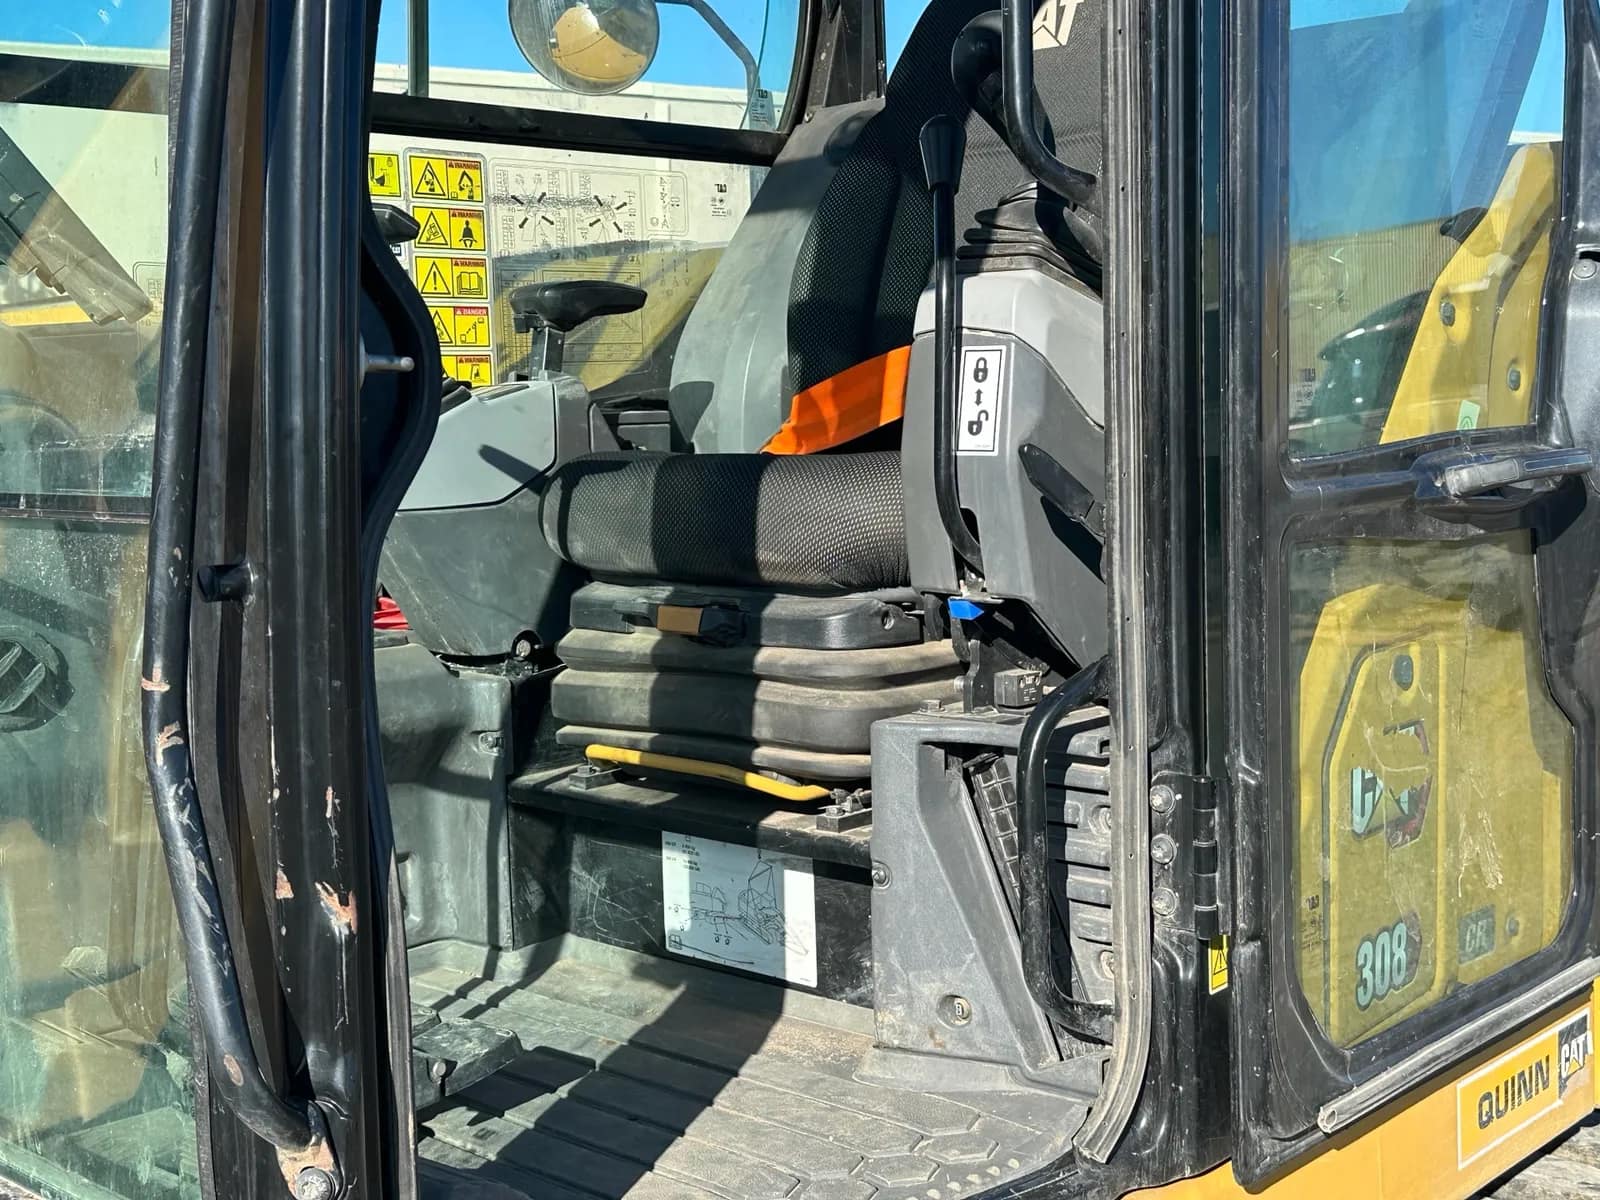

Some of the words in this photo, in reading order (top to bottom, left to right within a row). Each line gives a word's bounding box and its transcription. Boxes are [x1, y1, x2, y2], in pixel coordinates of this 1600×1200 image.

[1032, 0, 1085, 50] AT
[454, 162, 480, 170] WARNING
[1355, 920, 1409, 1009] 308
[1477, 1053, 1551, 1130] QUINN
[1560, 1033, 1587, 1080] CAT
